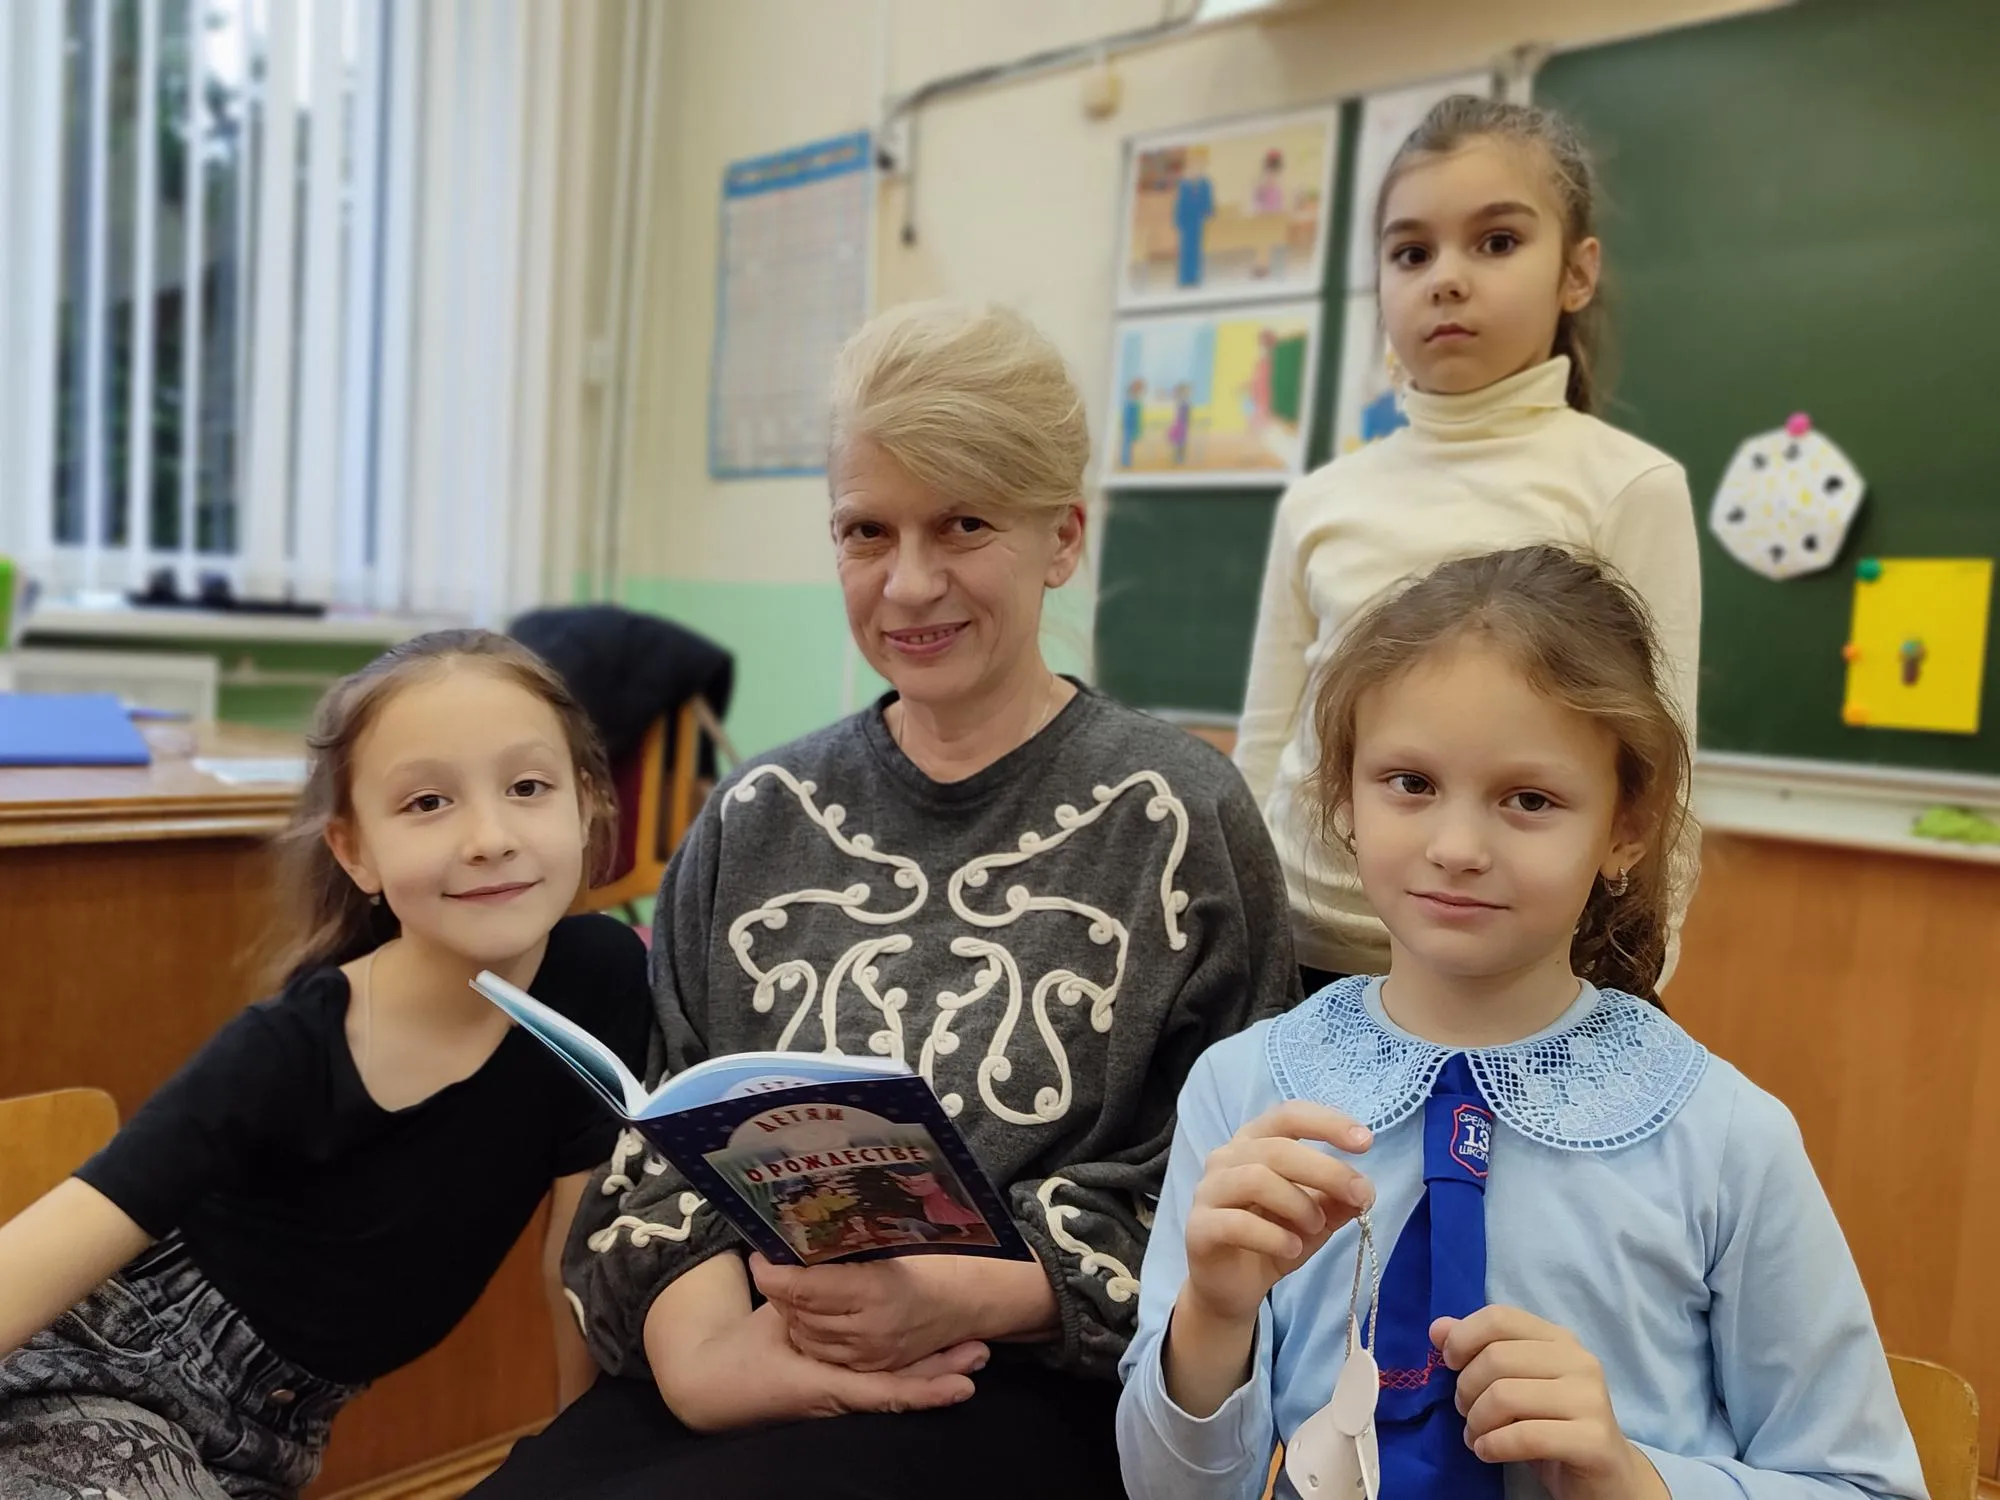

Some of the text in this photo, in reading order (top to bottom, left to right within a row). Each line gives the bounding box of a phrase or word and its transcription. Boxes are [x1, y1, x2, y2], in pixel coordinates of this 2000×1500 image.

[753, 1108, 844, 1133] ДЕТЯМ
[1459, 1112, 1492, 1134] СРЕДН
[1463, 1125, 1490, 1153] 13
[744, 1146, 926, 1183] О РОЖДЕСТВЕ
[1458, 1145, 1489, 1164] ШКОЛ
